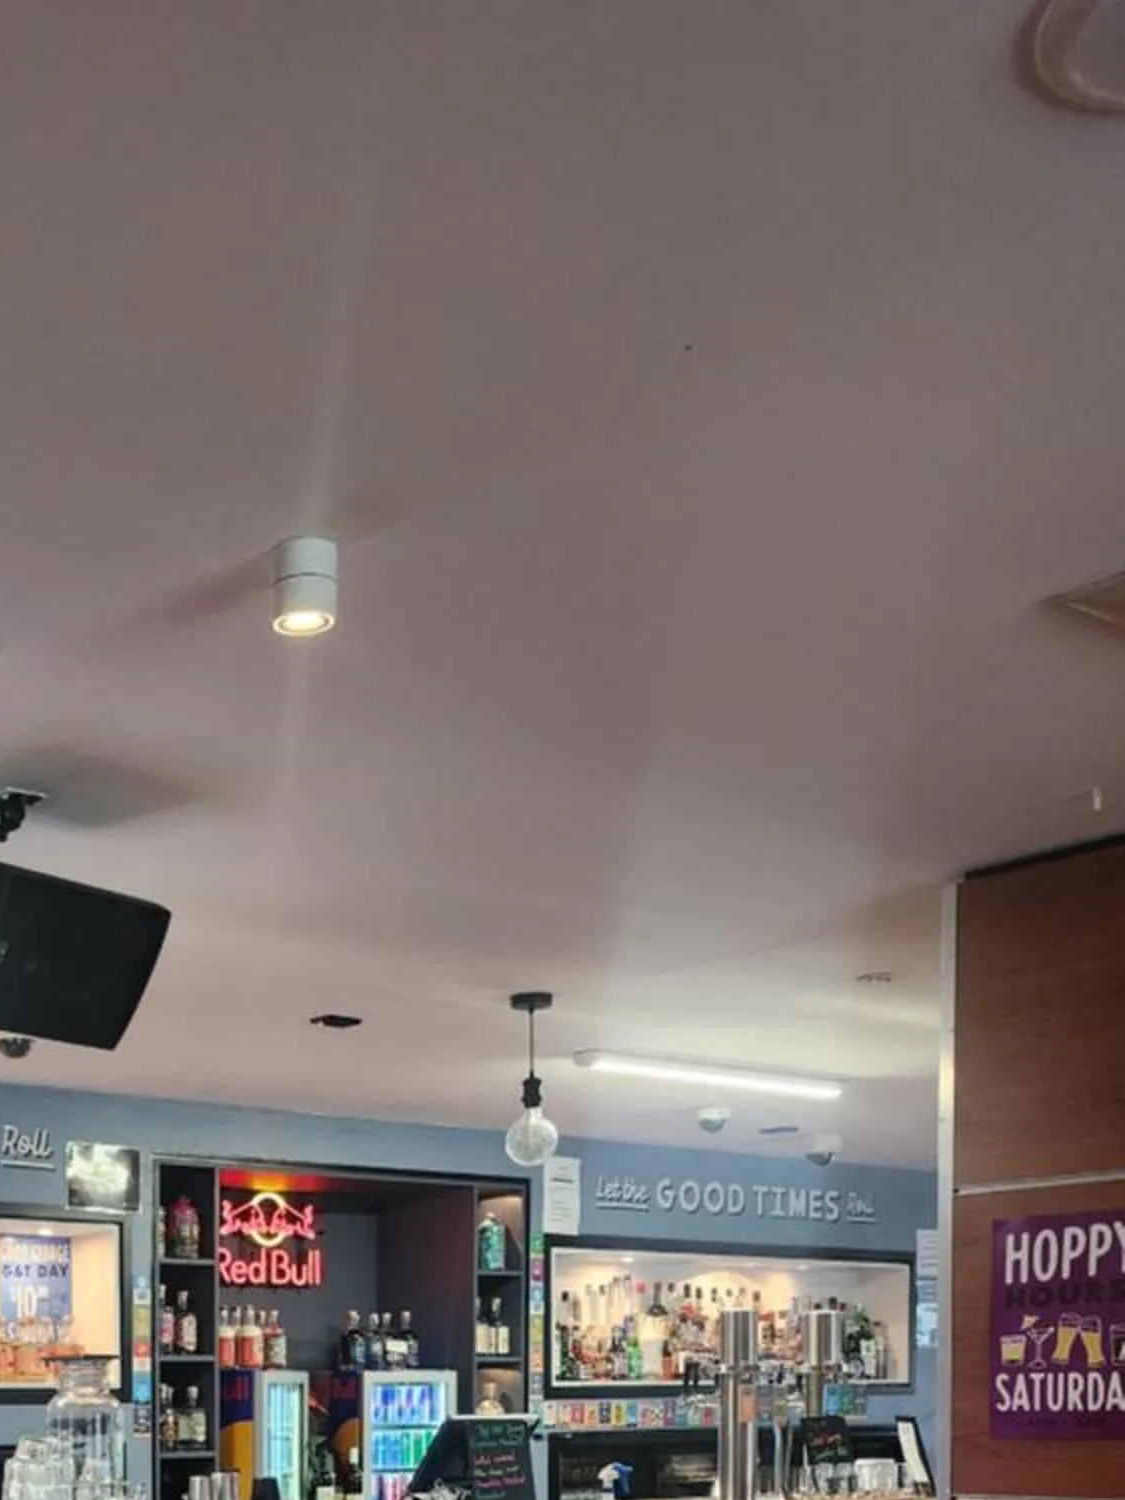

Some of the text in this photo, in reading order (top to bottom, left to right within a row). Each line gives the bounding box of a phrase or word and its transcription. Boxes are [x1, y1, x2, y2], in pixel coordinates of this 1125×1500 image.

[0, 1124, 54, 1159] Roll
[656, 1177, 746, 1215] GOOD
[752, 1184, 840, 1221] TIMES
[37, 1264, 69, 1279] DAY
[219, 1247, 321, 1287] Red Bull
[994, 1371, 1125, 1412] SATURDA
